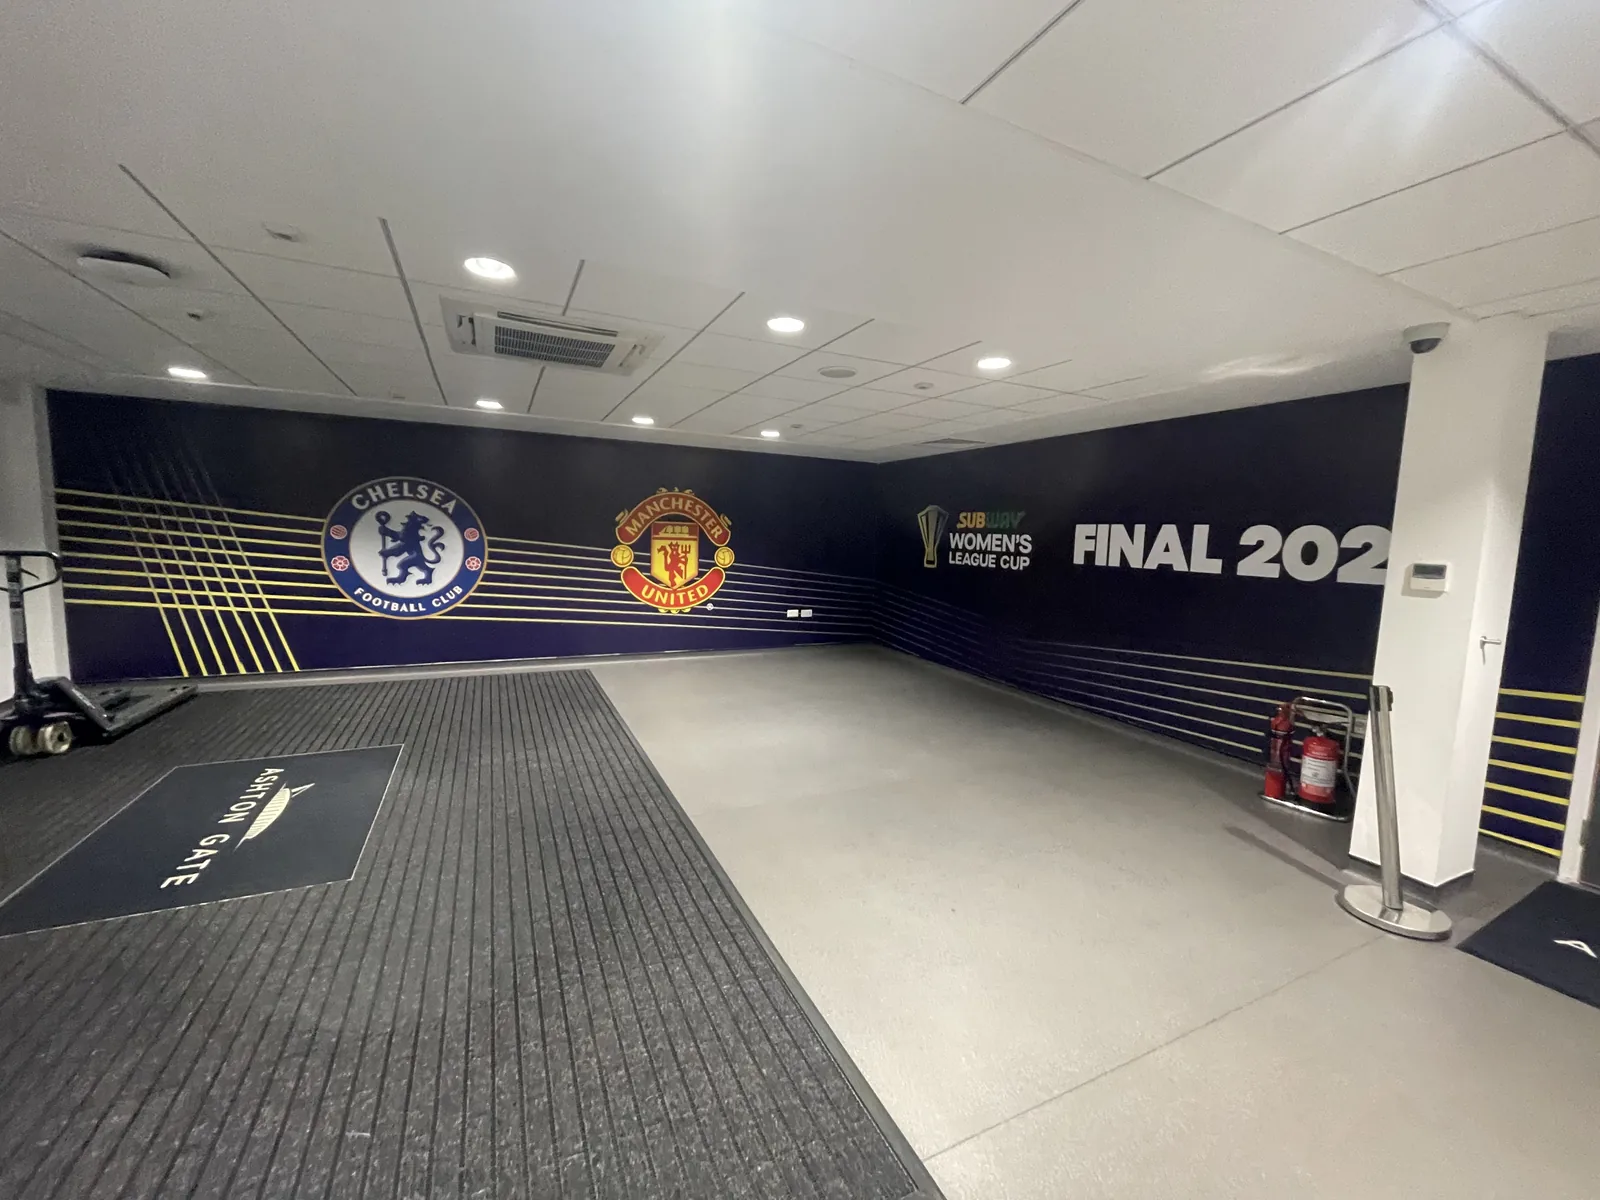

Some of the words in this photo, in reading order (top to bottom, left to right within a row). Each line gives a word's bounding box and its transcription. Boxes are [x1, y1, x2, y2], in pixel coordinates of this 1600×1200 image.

[351, 481, 457, 514] CHELSEA
[625, 497, 724, 539] MANCHESTER
[956, 510, 1027, 529] SUBWAY
[949, 532, 1033, 554] WOMEN'S
[1073, 523, 1223, 575] FINAL
[1236, 524, 1393, 585] 202
[948, 551, 997, 568] LEAGUE
[1000, 555, 1031, 571] CUP
[354, 587, 426, 612] FOOTBALL
[431, 585, 464, 608] CLUB
[641, 584, 709, 606] UNITED
[217, 767, 285, 824] ASHTON
[159, 833, 230, 889] GATE
